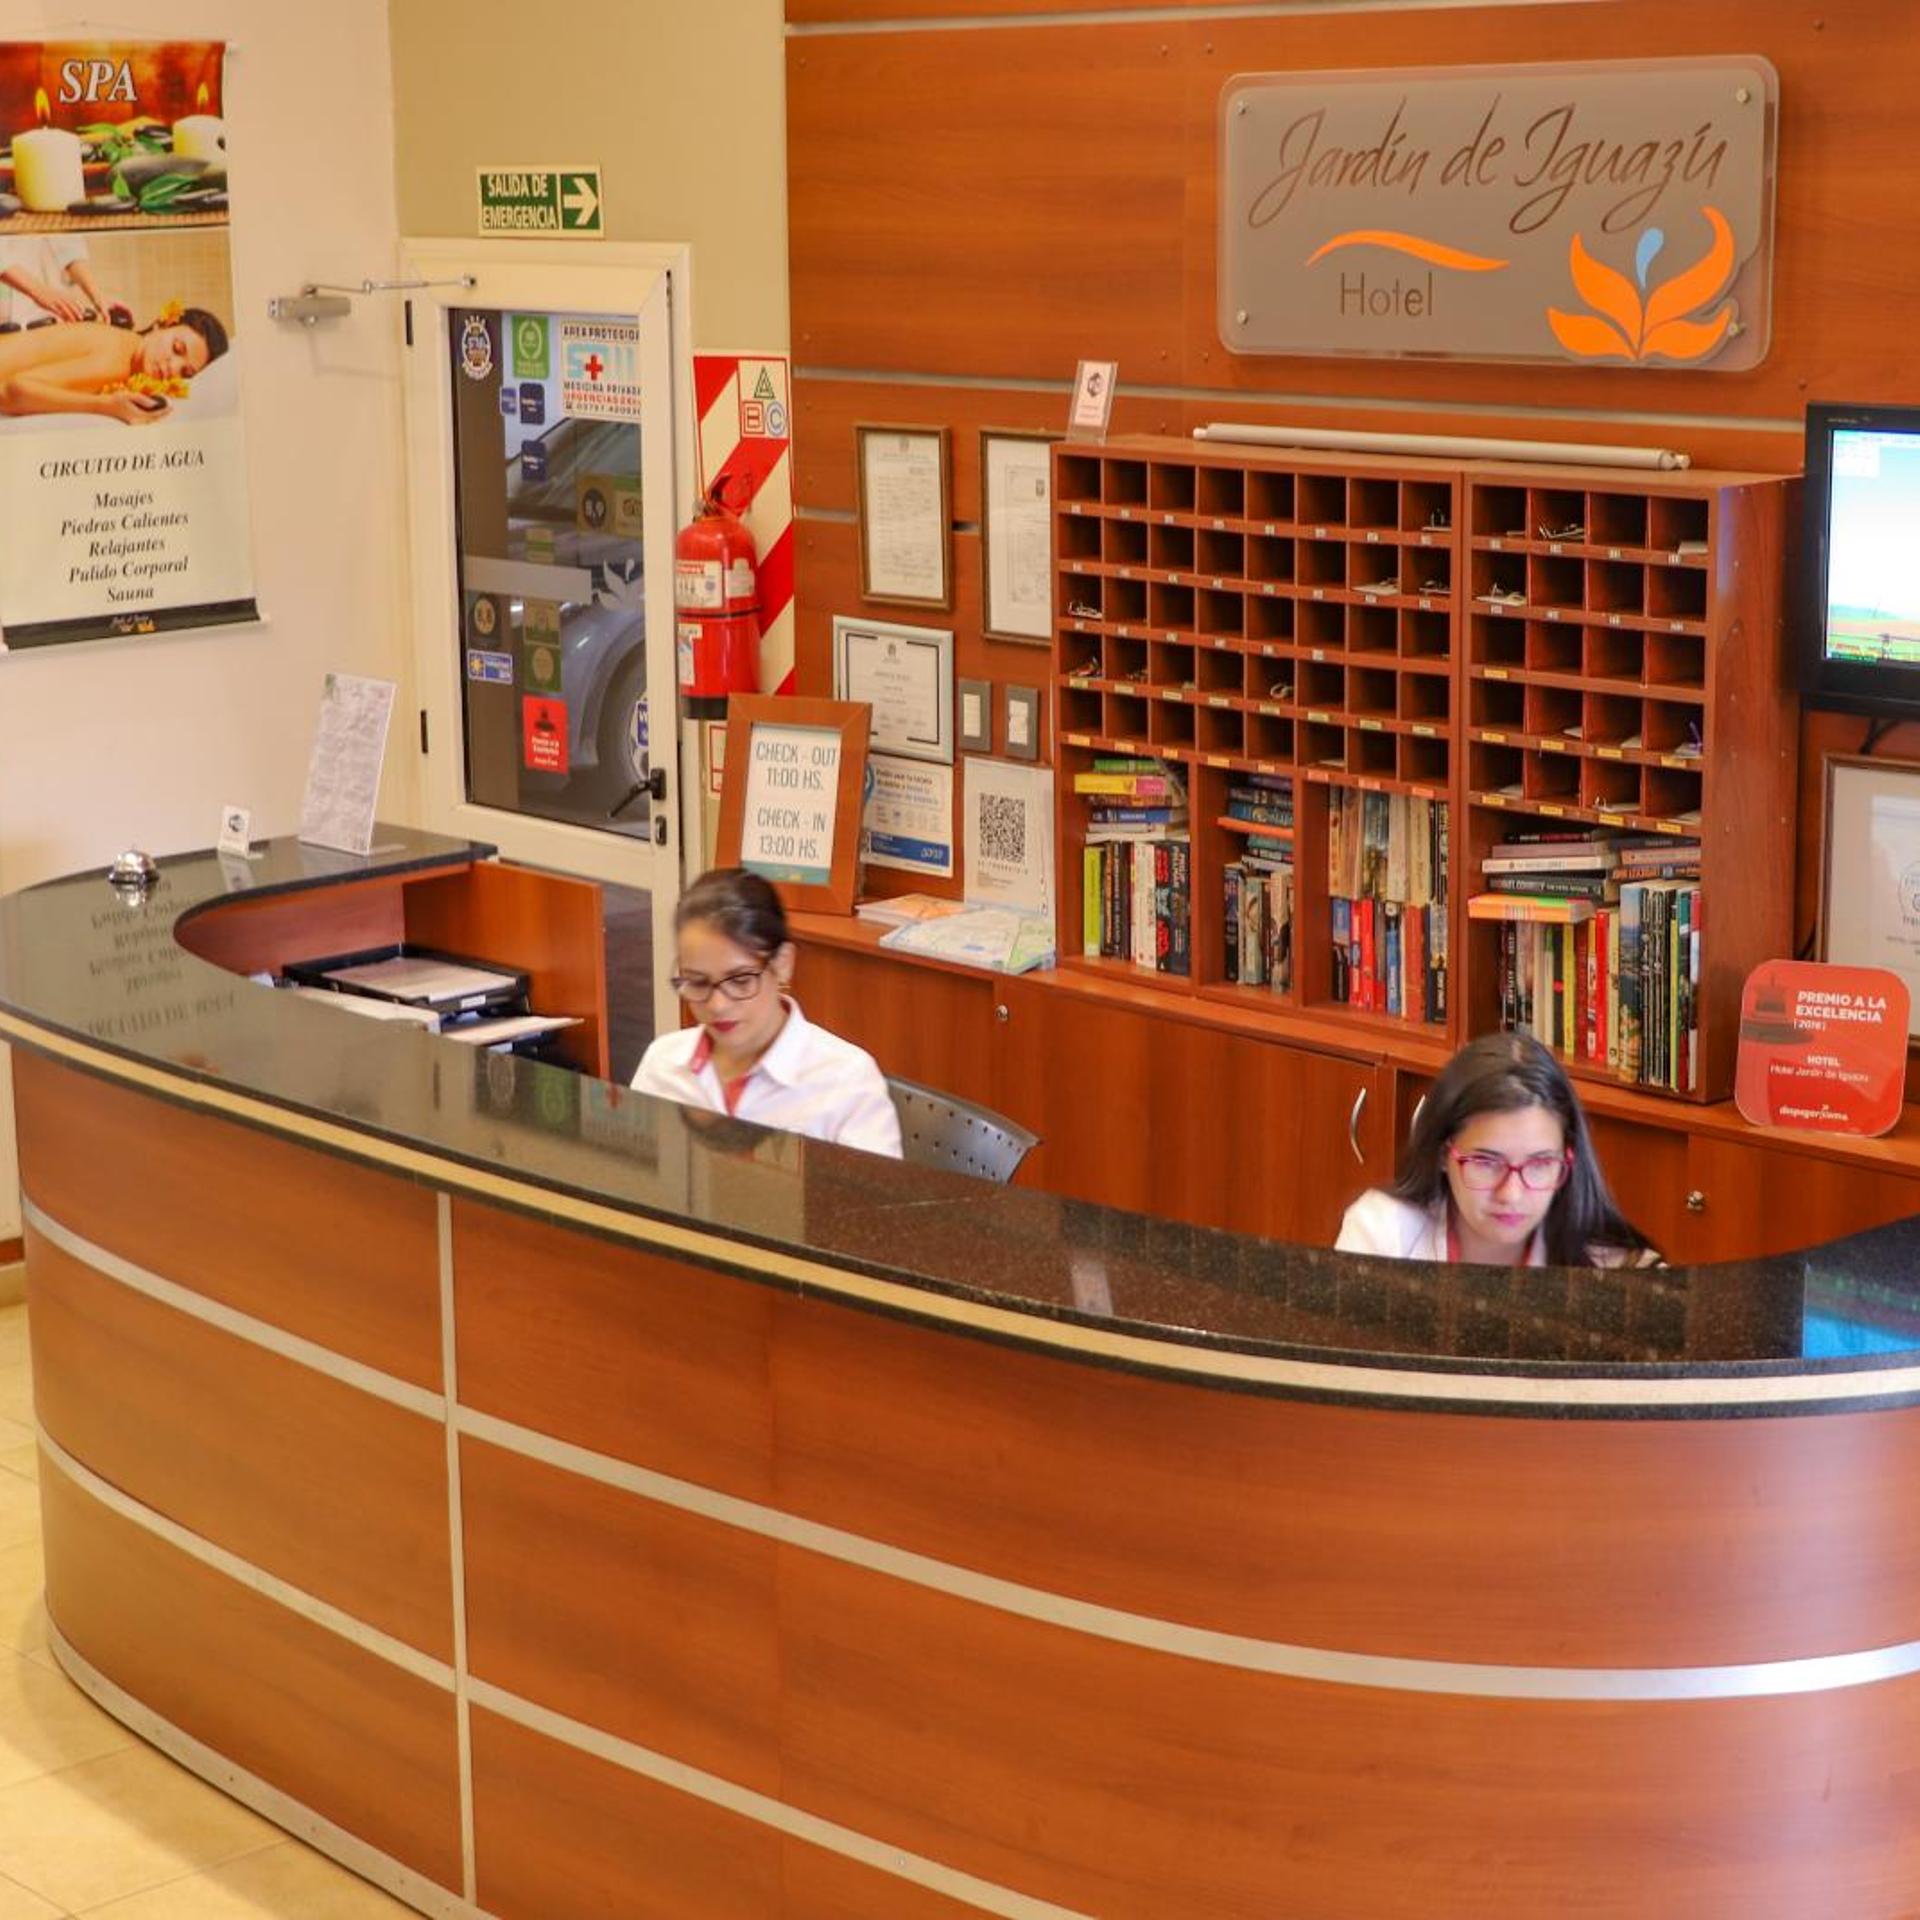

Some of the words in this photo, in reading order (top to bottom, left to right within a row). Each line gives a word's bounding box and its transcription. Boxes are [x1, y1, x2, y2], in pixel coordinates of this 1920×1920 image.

[58, 58, 138, 104] SPA
[1249, 96, 1430, 229] Jardín
[1441, 92, 1506, 188] de
[1508, 102, 1728, 234] Iguazú
[488, 174, 531, 197] SALIDA
[532, 174, 549, 197] DE
[482, 206, 558, 229] EMERGENCIA
[1340, 271, 1433, 317] Hotel
[39, 458, 127, 479] CIRCUITO
[131, 454, 156, 471] DE
[160, 450, 205, 468] AGUA
[94, 490, 154, 510] Masajes
[61, 517, 116, 537] Piedras
[121, 512, 189, 531] Calientes
[88, 539, 165, 559] Relajantes
[69, 566, 117, 584] Pulido
[122, 556, 189, 580] Corporal
[106, 585, 154, 603] Sauna
[756, 741, 798, 764] CHECK
[811, 746, 836, 767] OUT
[767, 766, 798, 788] 11:00
[802, 768, 824, 791] HS.
[757, 807, 800, 830] CHECK
[813, 812, 826, 833] IN
[760, 835, 795, 857] 13:00
[799, 838, 820, 860] HS.
[1797, 991, 1852, 1006] PREMIO
[1853, 996, 1865, 1008] A
[1868, 997, 1887, 1010] LA
[1795, 1004, 1882, 1023] EXCELENCIA
[1770, 1064, 1795, 1075] Hotel
[1824, 1069, 1837, 1079] de
[1807, 1055, 1840, 1067] HOTEL
